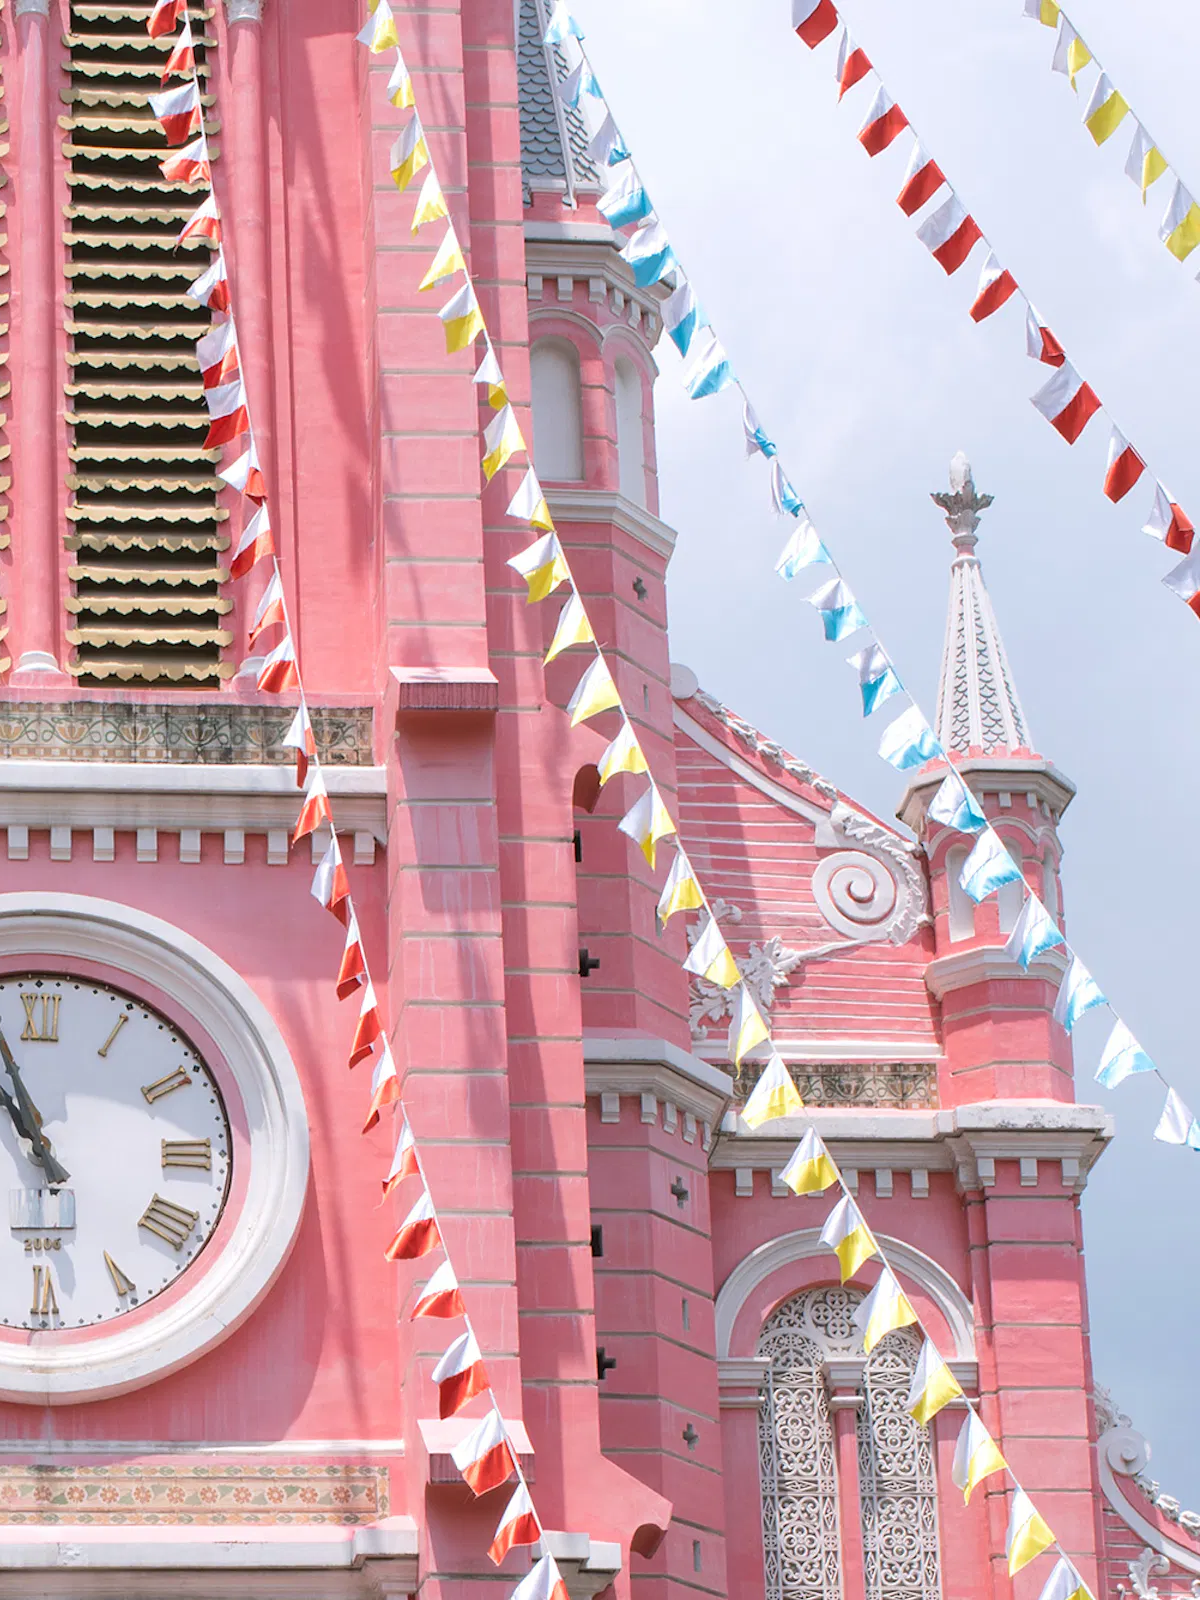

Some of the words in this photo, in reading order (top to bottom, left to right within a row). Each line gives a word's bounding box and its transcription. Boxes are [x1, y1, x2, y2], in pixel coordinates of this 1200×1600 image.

[20, 992, 62, 1042] XII
[97, 1013, 128, 1057] I
[161, 1137, 211, 1171] III
[23, 1238, 62, 1251] 2006
